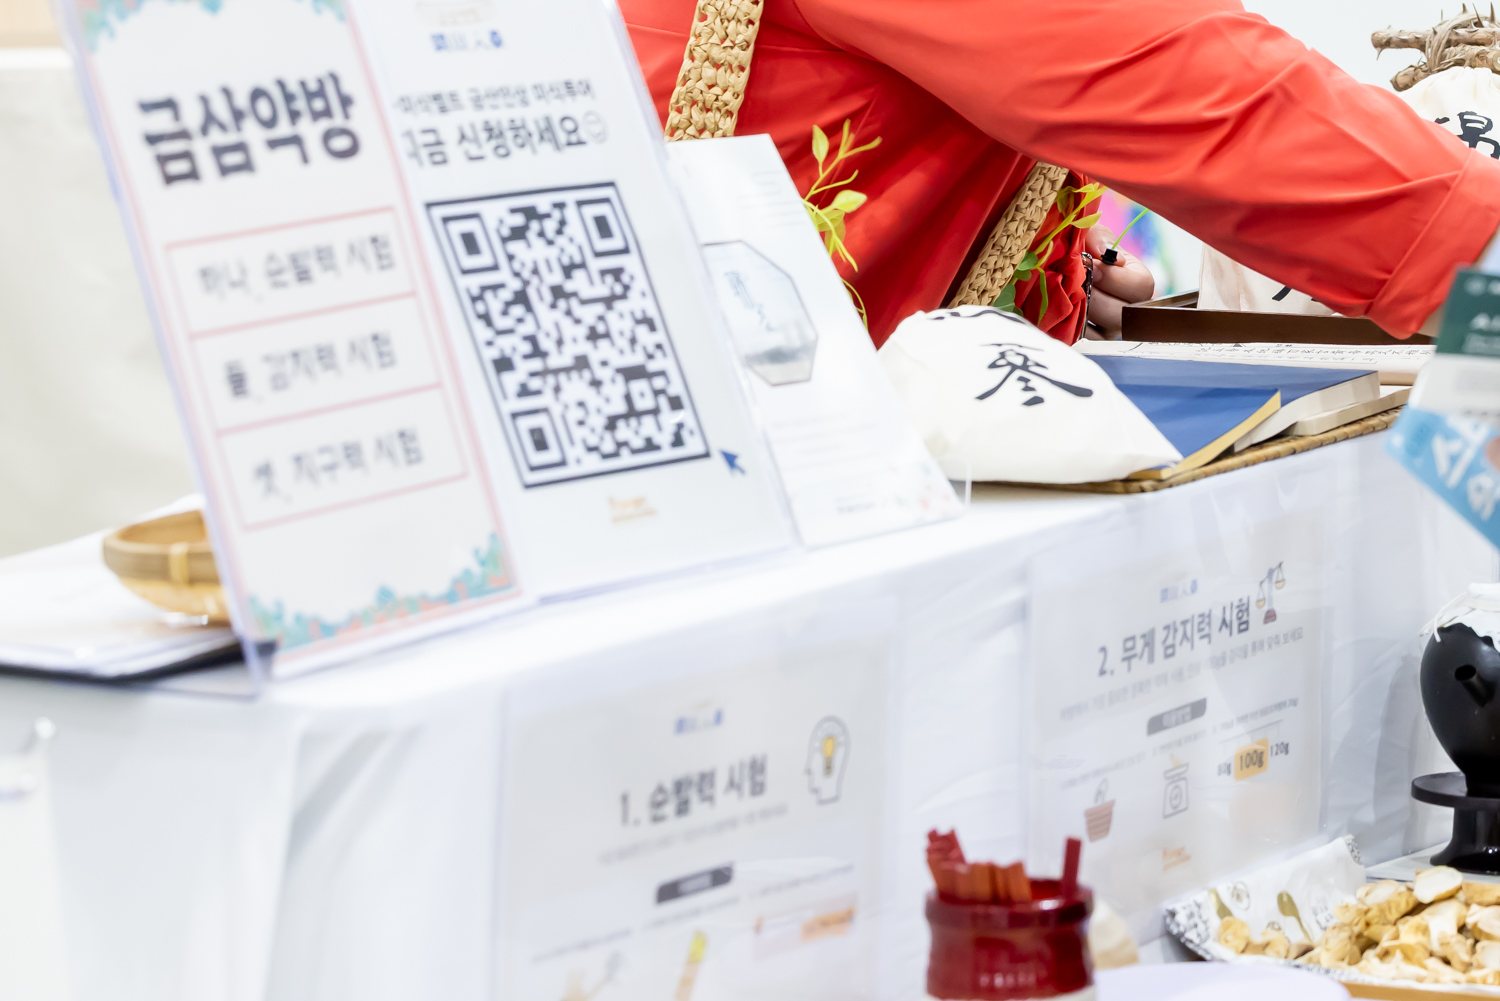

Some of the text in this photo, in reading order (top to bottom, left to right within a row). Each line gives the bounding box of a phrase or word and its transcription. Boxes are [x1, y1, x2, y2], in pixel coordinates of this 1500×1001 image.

[137, 71, 361, 185] 금삼약방
[457, 113, 587, 162] 신청하세요
[347, 233, 396, 273] 시험
[348, 331, 396, 371] 시험
[374, 427, 424, 468] 시험
[1097, 595, 1250, 677] 2. 무게 감지력 시험
[1240, 749, 1264, 771] 100g
[1270, 741, 1289, 757] 120g
[648, 767, 717, 824] 순발력
[722, 753, 767, 800] 시험
